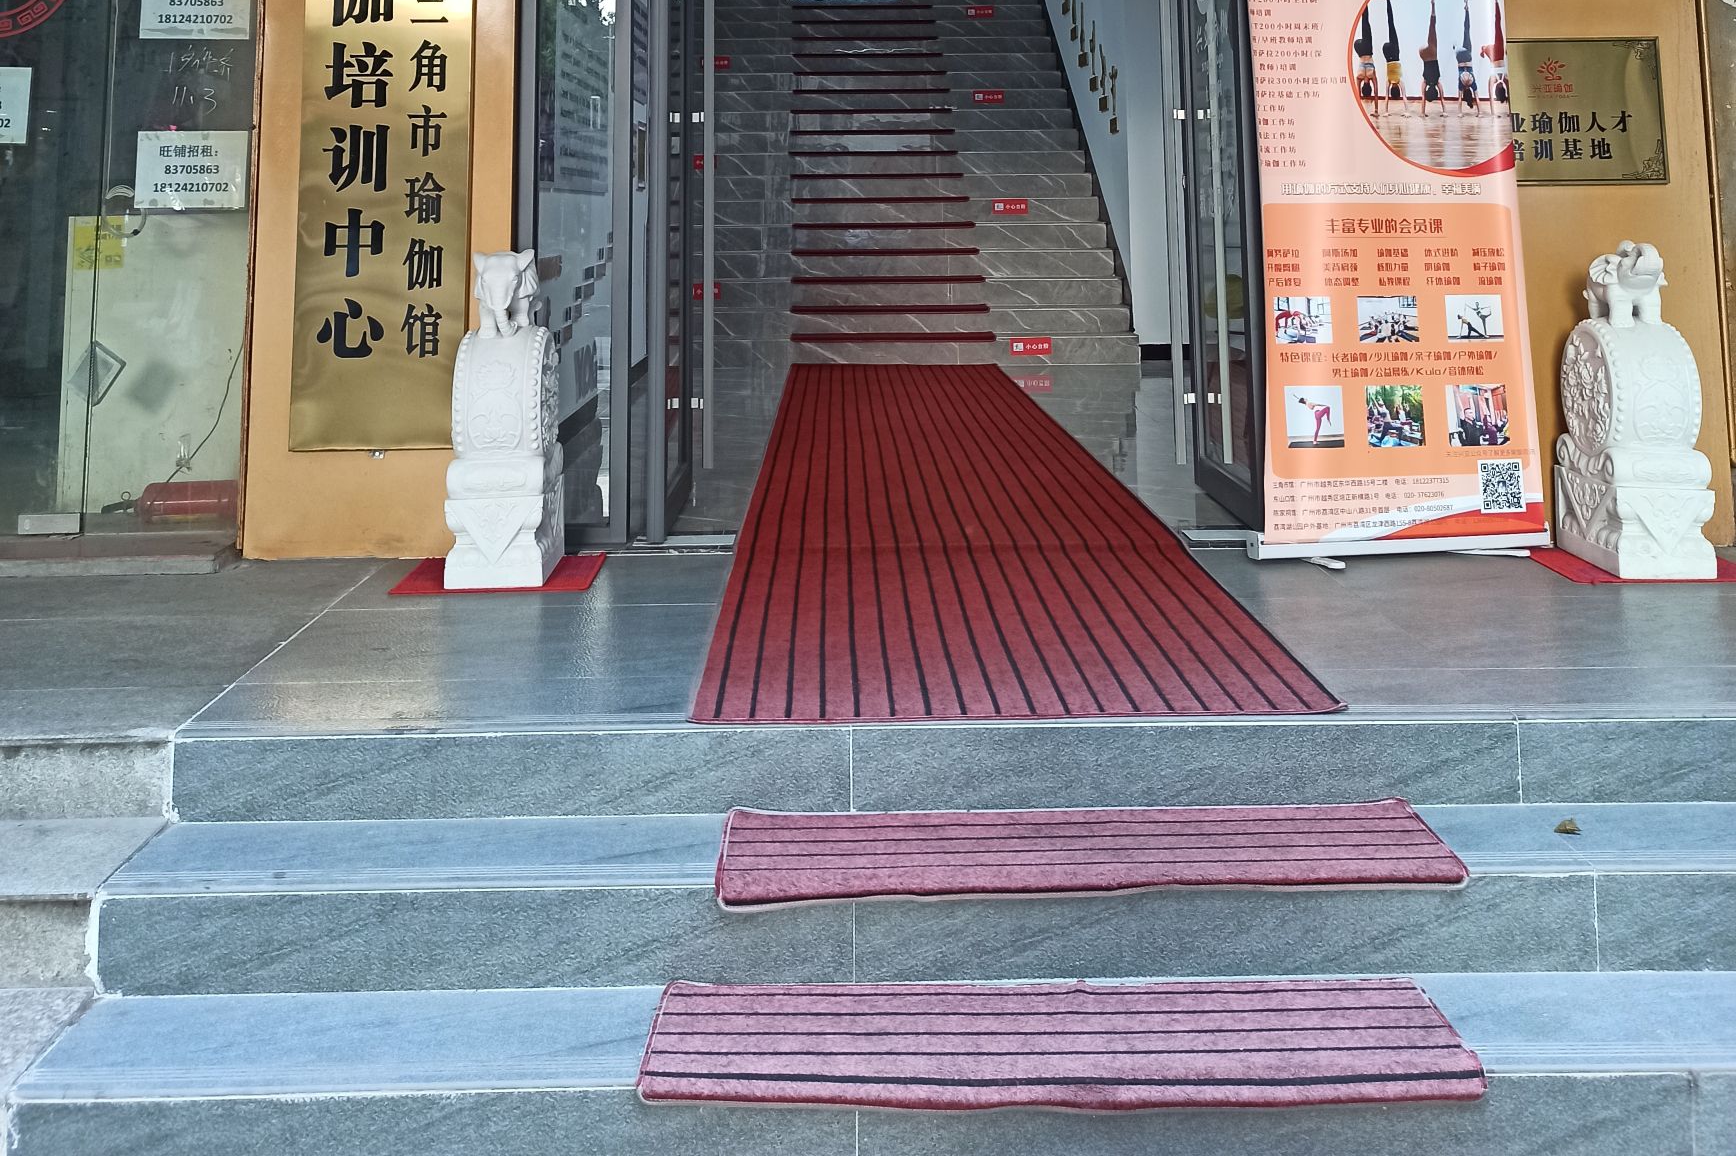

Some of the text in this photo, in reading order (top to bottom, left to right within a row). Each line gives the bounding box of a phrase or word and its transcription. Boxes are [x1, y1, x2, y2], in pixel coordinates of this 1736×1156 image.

[158, 14, 233, 25] 18124210702
[164, 163, 219, 175] 83705863
[153, 181, 229, 193] 18124210702
[1325, 218, 1444, 234] 丰富专业的会员课
